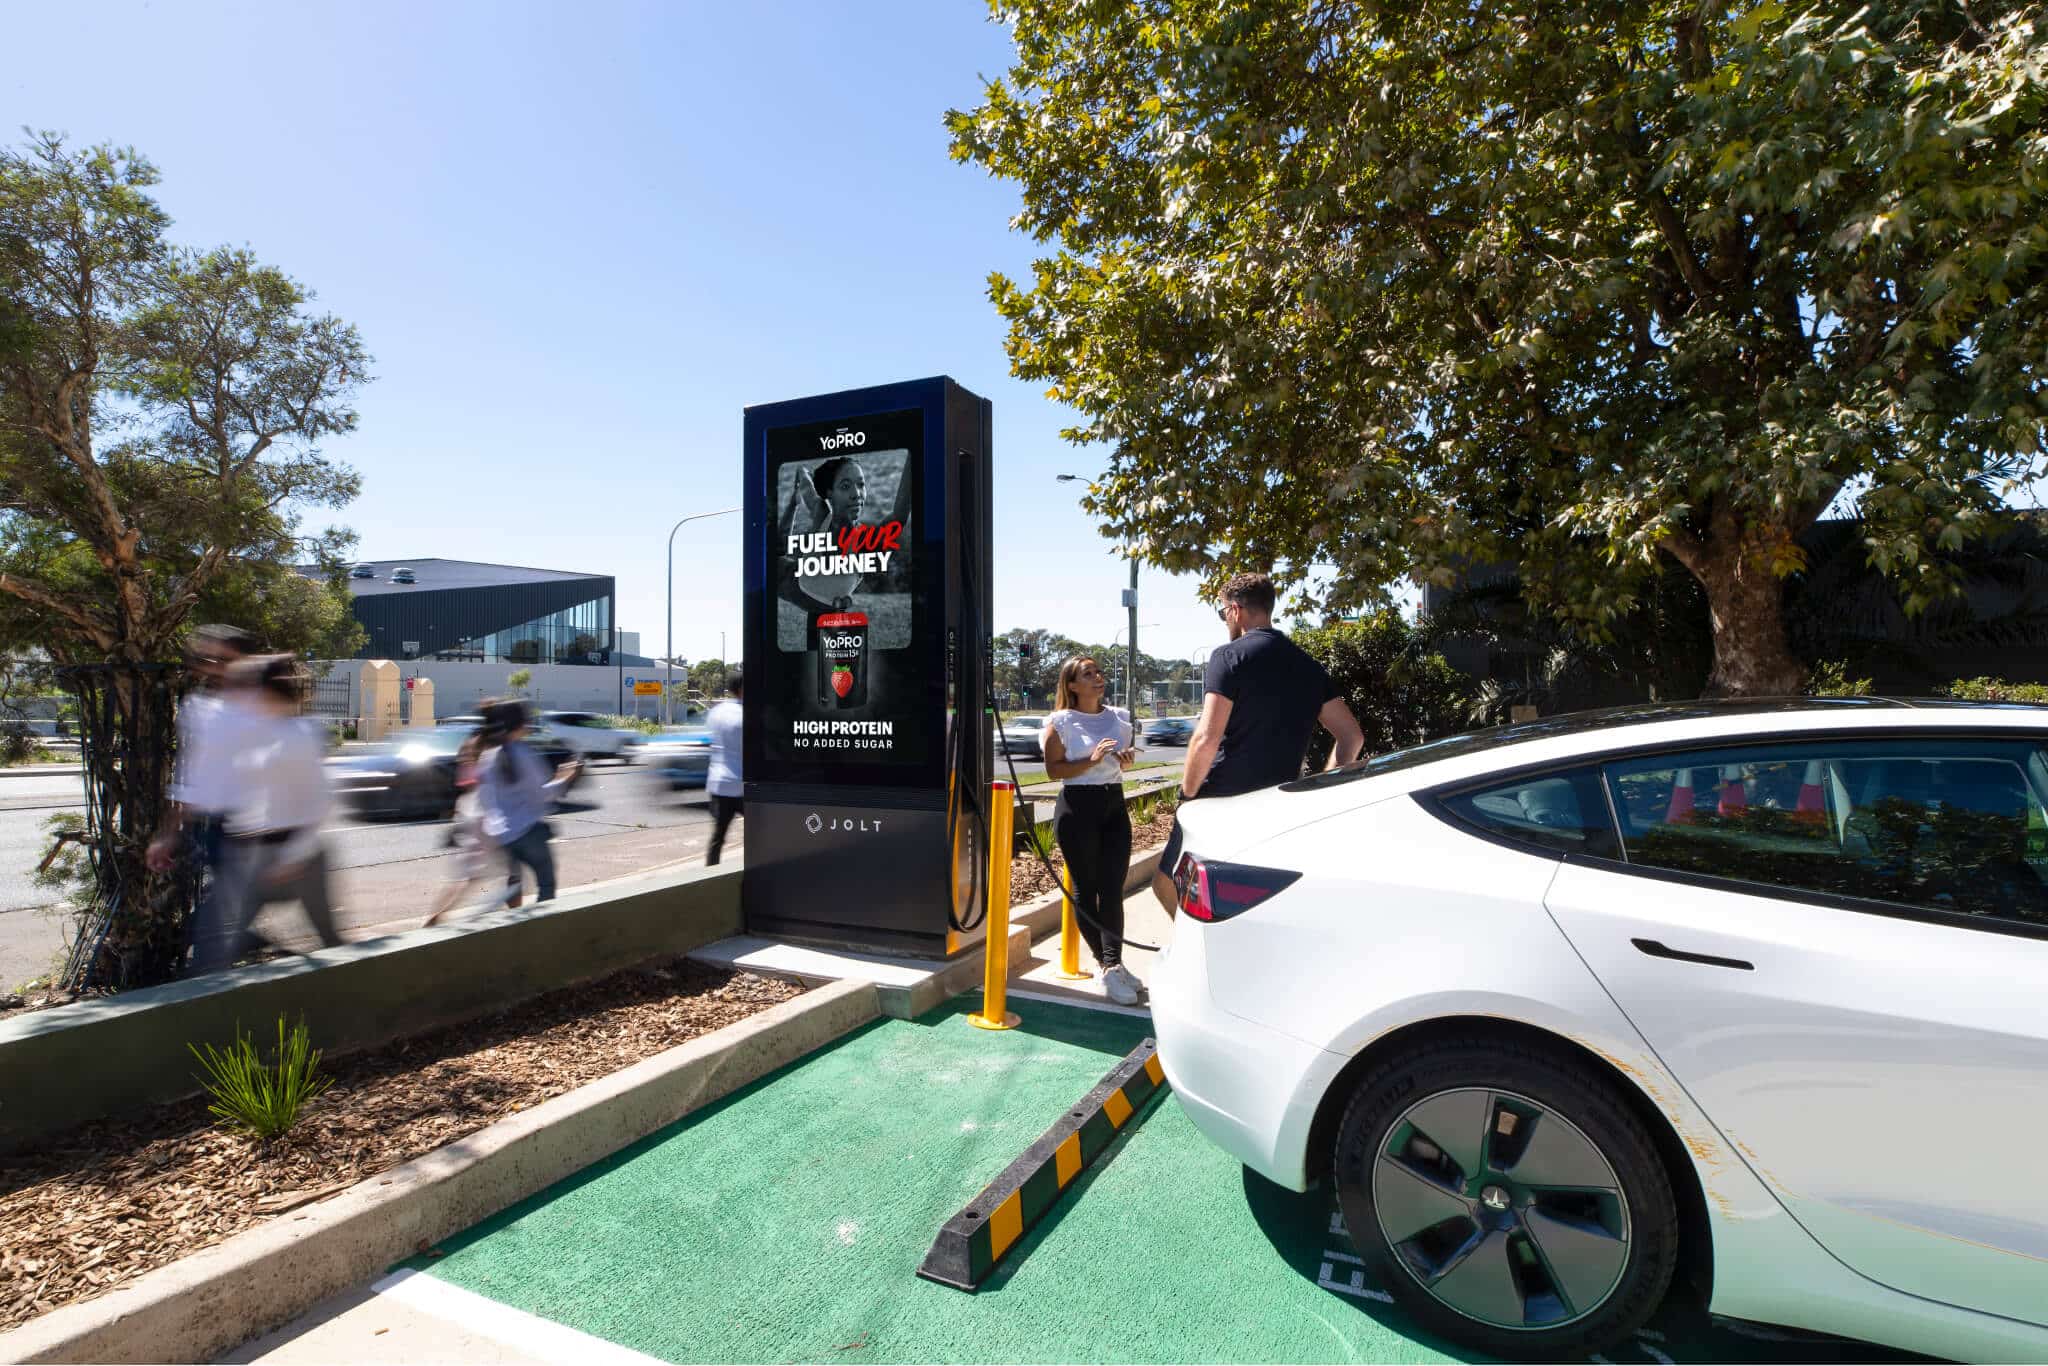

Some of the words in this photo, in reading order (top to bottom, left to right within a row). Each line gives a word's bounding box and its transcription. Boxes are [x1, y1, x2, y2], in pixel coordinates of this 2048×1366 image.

[820, 432, 866, 450] YoPRO
[788, 532, 837, 554] FUEL
[838, 521, 903, 557] YOUR
[794, 551, 892, 577] JOURNEY
[823, 635, 863, 649] YoPRO
[793, 721, 829, 735] HIGH
[831, 721, 893, 735] PROTEIN
[794, 738, 809, 748] NO
[813, 739, 850, 748] ADDED
[854, 739, 893, 750] SUGAR
[830, 818, 882, 832] JOLT
